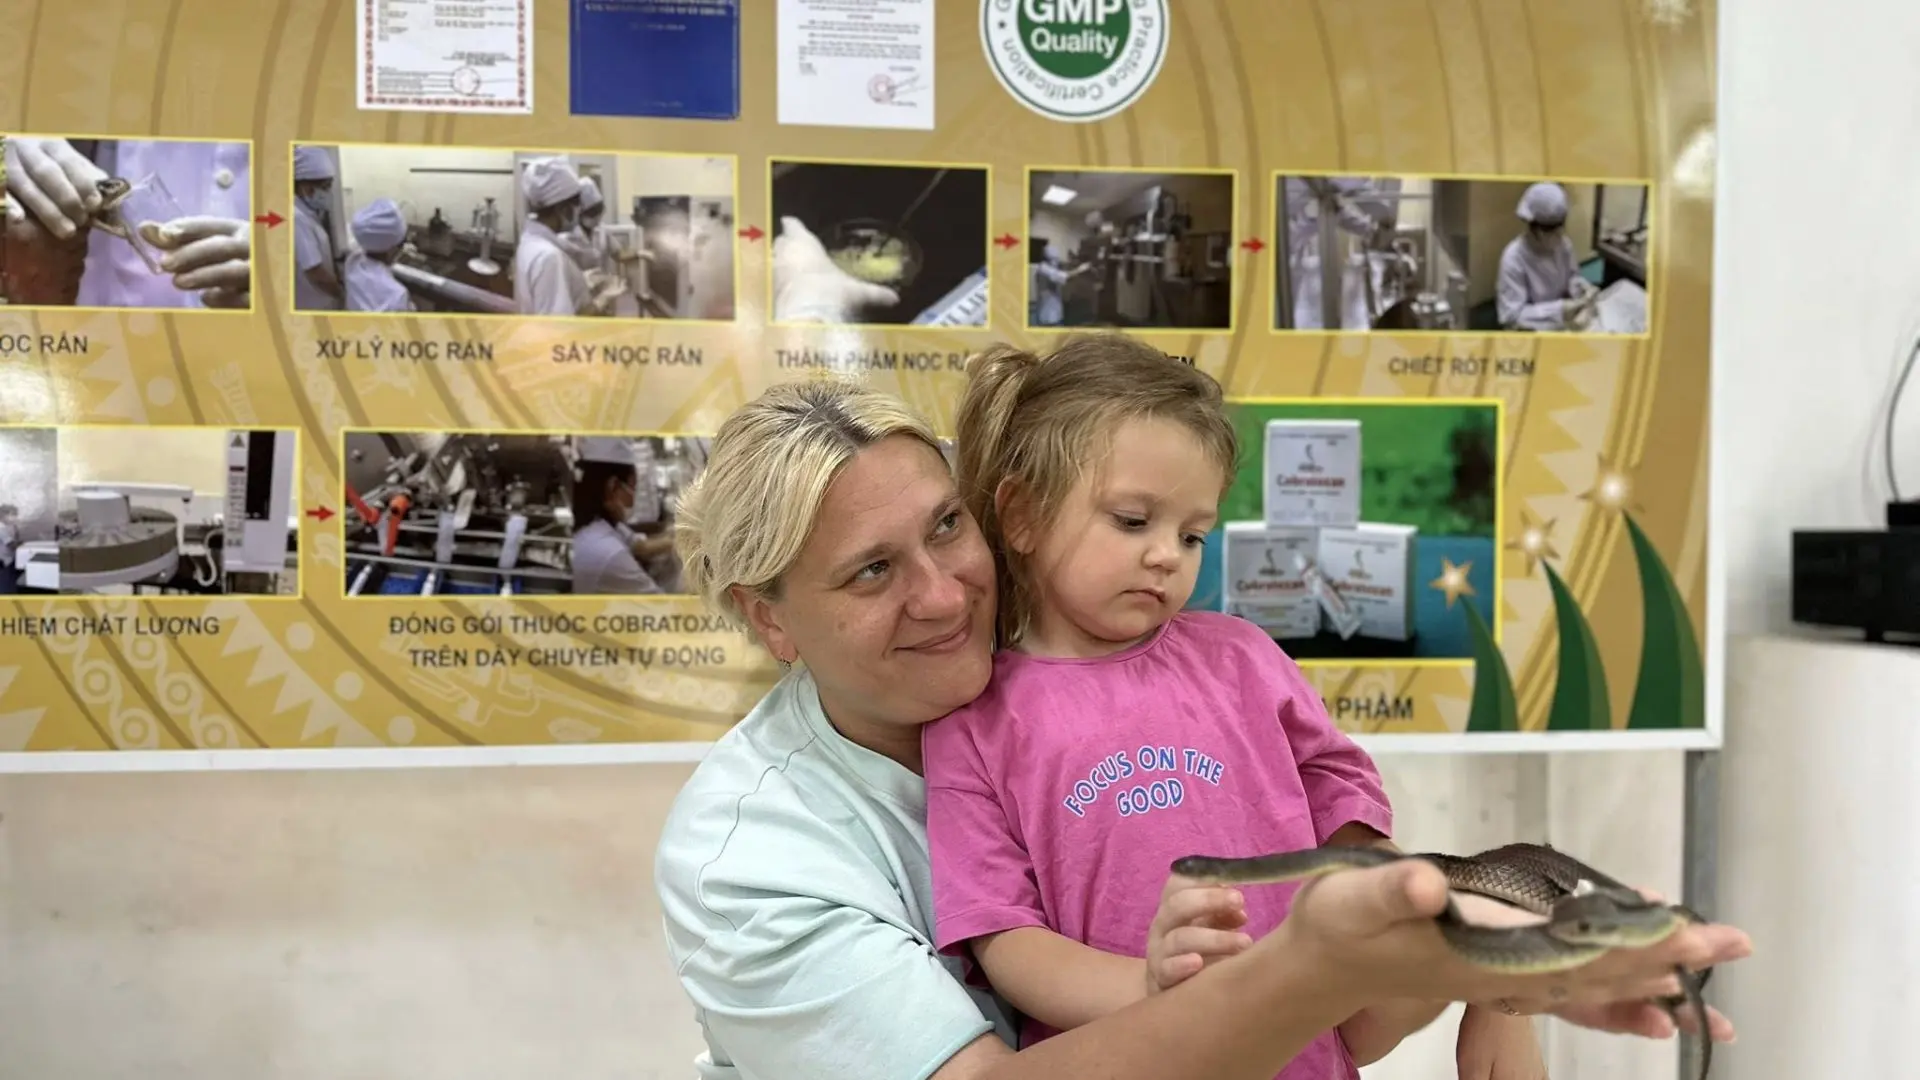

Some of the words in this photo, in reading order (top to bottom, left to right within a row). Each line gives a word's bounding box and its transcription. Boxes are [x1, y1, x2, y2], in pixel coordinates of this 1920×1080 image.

[1024, 0, 1122, 24] GMP
[1031, 28, 1118, 58] Quality
[1107, 16, 1153, 87] Practice
[593, 614, 735, 634] COBRATOXA
[1064, 751, 1135, 817] FOCUS
[1138, 745, 1177, 772] ON
[1183, 748, 1224, 786] THE
[1116, 777, 1185, 817] GOOD
